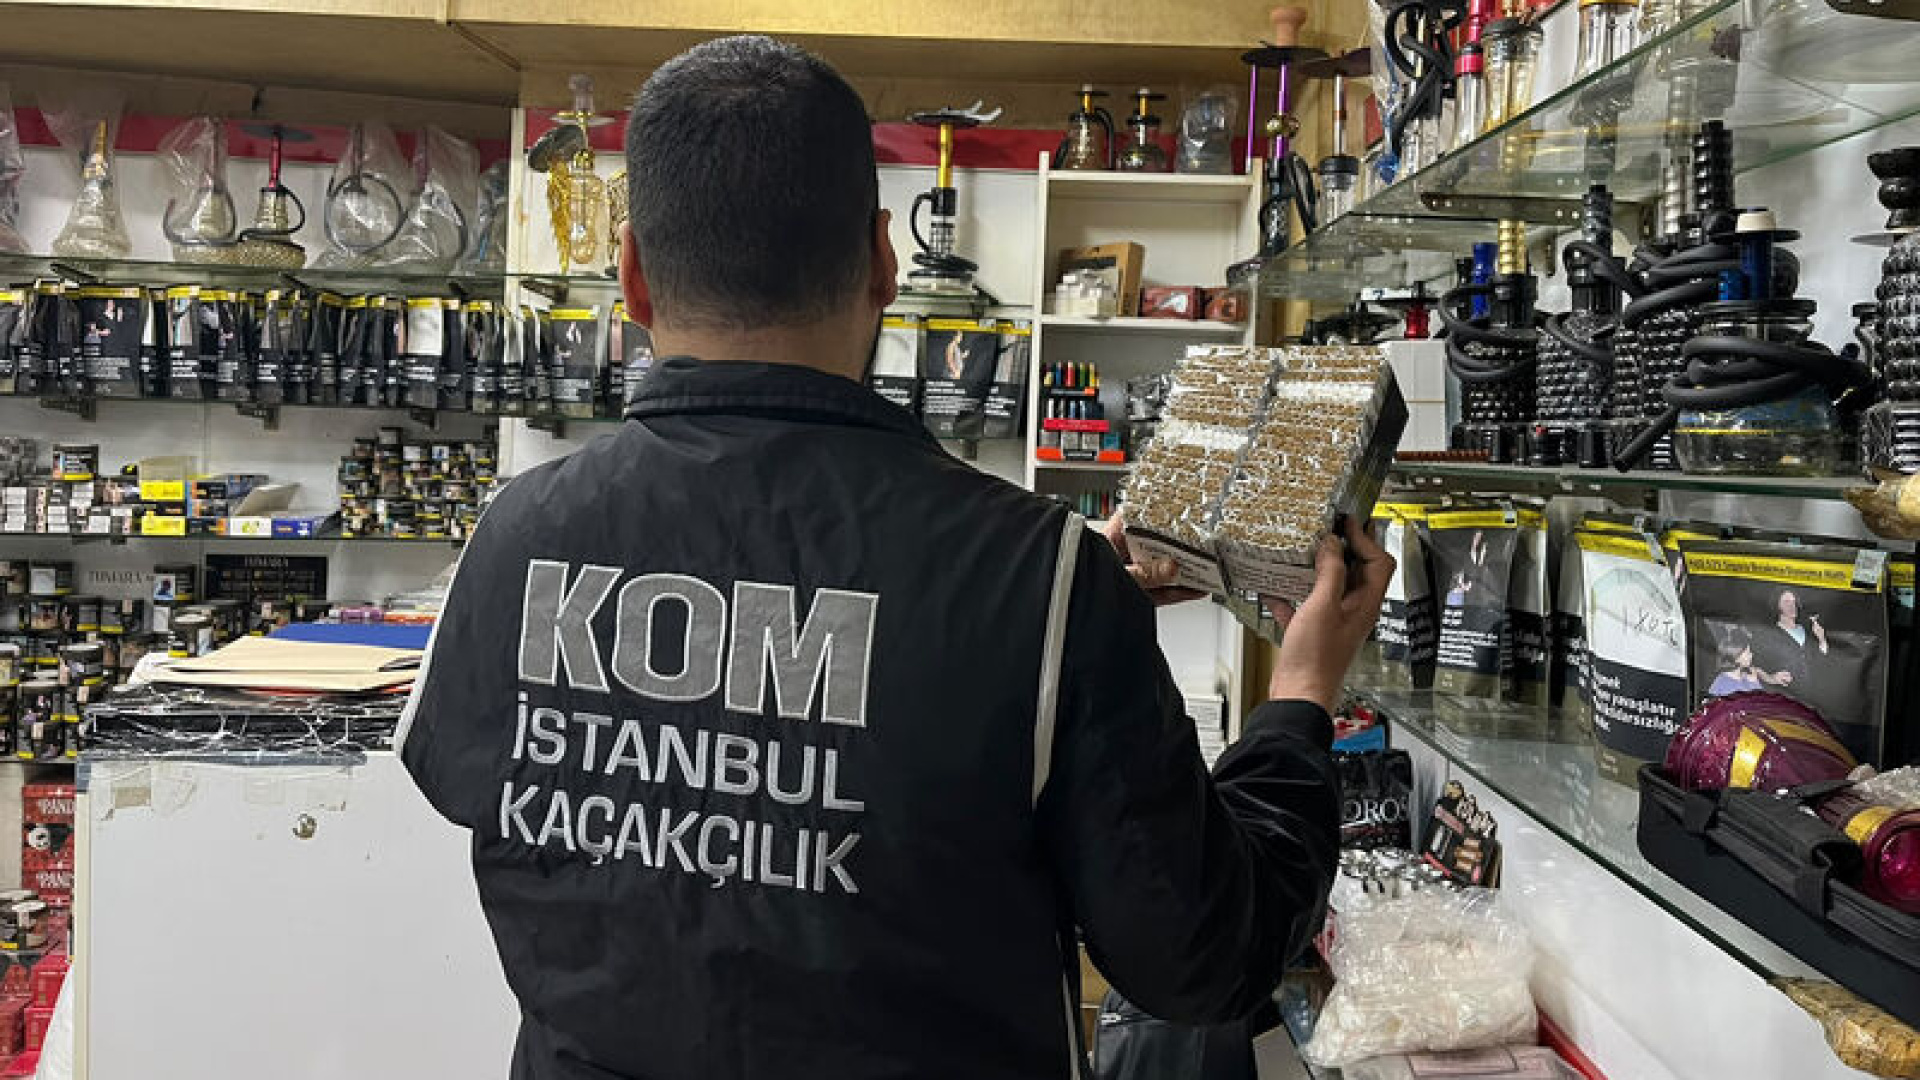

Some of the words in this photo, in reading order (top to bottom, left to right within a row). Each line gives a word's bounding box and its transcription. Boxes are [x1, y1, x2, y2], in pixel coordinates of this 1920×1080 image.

[517, 558, 879, 728] KOM
[511, 691, 865, 812] İSTANBUL
[500, 781, 862, 895] KAÇAKÇILIK
